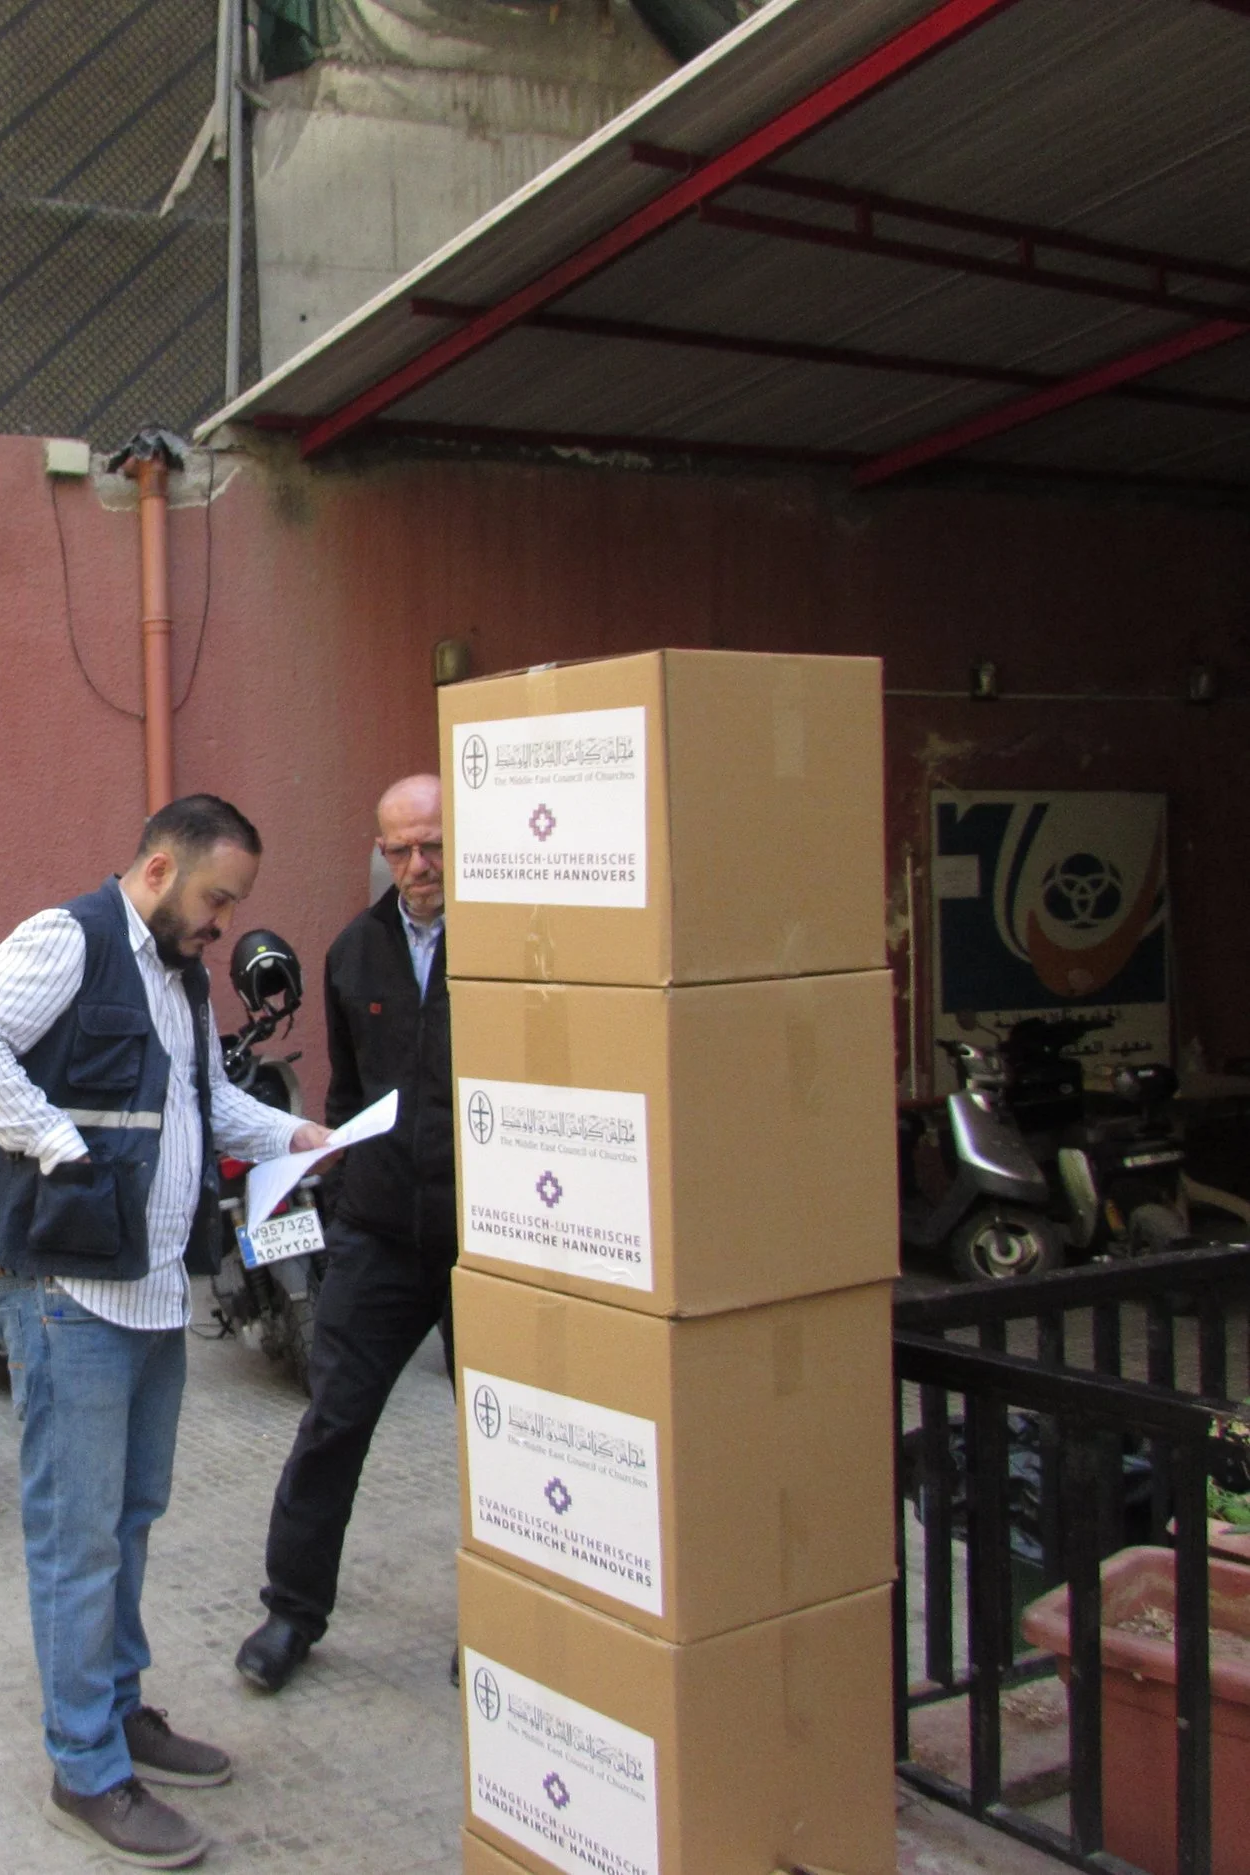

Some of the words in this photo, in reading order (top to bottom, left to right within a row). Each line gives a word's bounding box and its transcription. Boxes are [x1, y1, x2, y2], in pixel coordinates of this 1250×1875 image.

[495, 776, 506, 785] The
[595, 771, 635, 780] Churches
[463, 853, 636, 865] EVANGELISCH-LUTHERISCHE
[463, 868, 549, 880] LANDESKIRCHE
[554, 869, 636, 882] HANNOVERS
[500, 1136, 511, 1145] The
[540, 1142, 555, 1152] East
[598, 1149, 638, 1163] Churches
[471, 1204, 641, 1247] EVANGELISCH-LUTHERISCHE
[471, 1220, 558, 1247] LANDESKIRCHE
[562, 1237, 642, 1263] HANNOVERS
[478, 1494, 651, 1570] EVANGELISCH-LUTHERISCHE
[479, 1510, 566, 1553] LANDESKIRCHE
[571, 1547, 652, 1587] HANNOVERS
[478, 1787, 565, 1848] LANDESKIRCHE
[569, 1841, 623, 1875] HANNO
